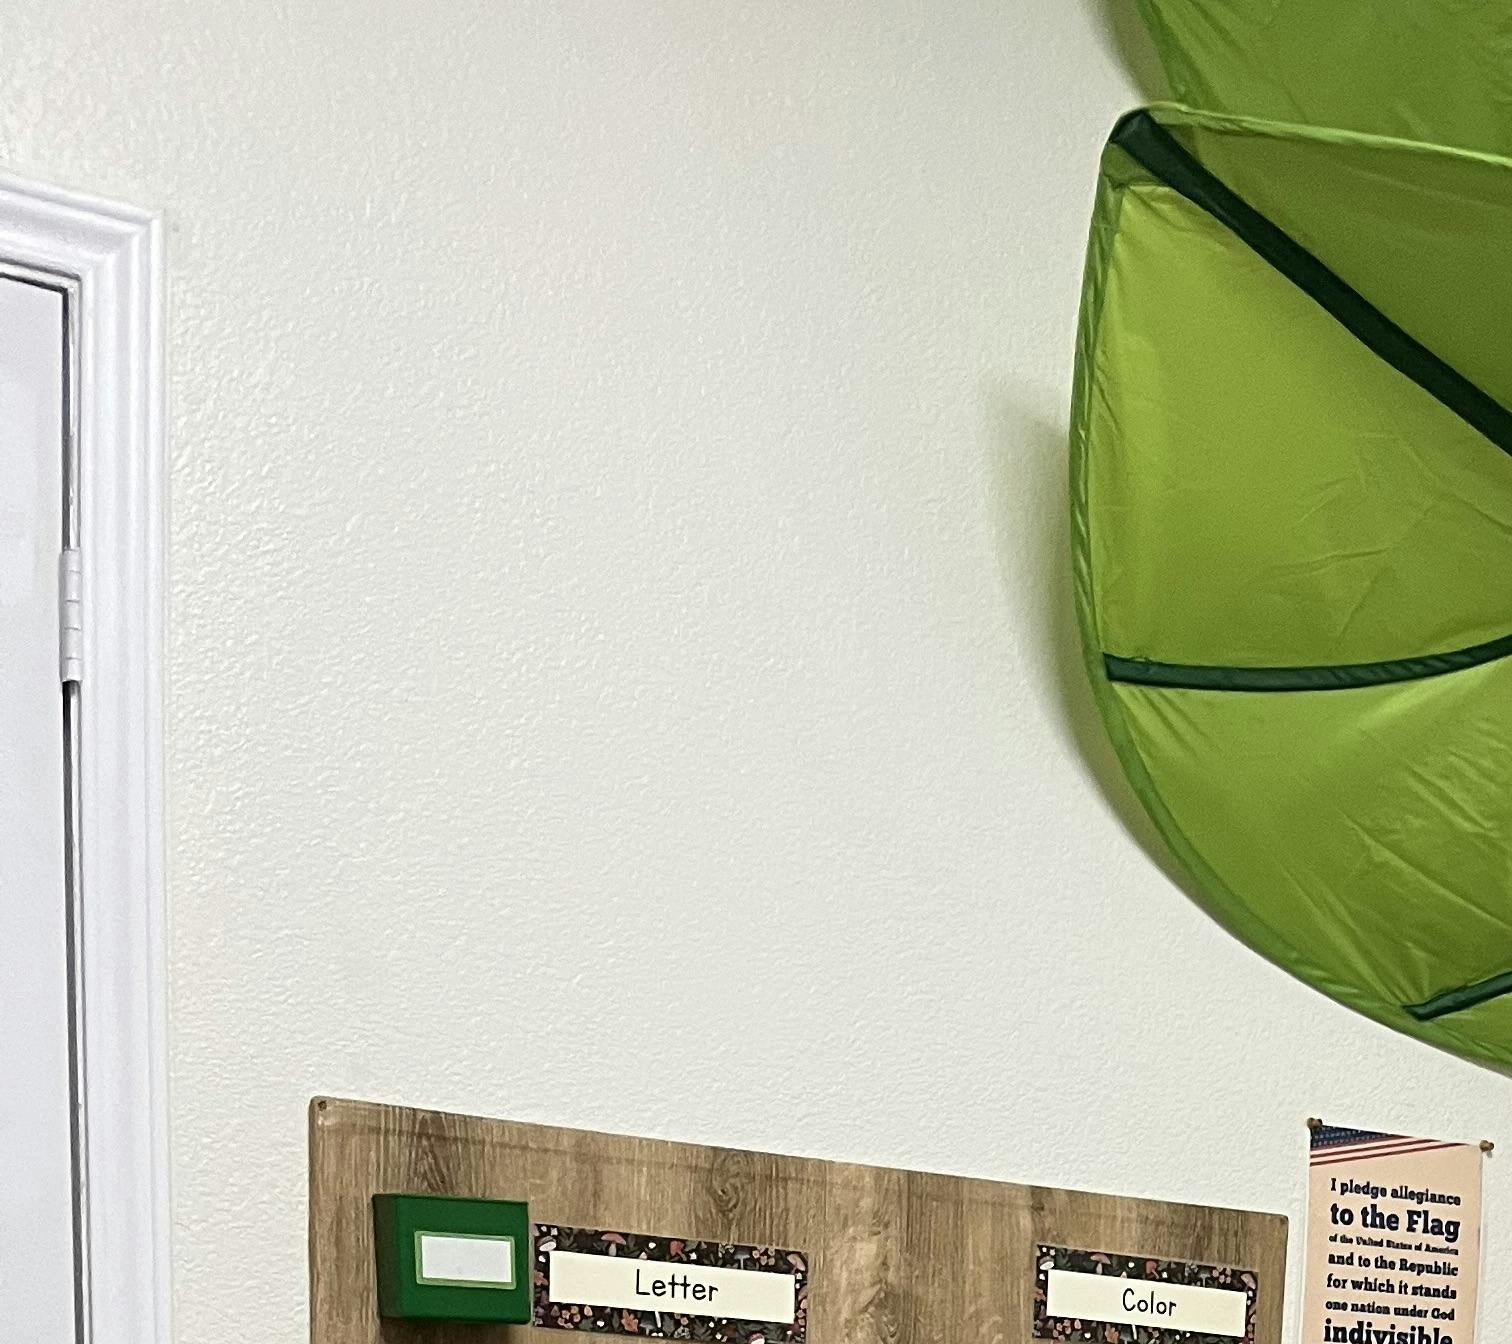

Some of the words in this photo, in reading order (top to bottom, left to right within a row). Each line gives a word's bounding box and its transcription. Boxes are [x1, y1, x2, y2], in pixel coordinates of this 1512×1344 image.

[1331, 1178, 1336, 1191] I
[1341, 1179, 1387, 1199] pledge
[1391, 1185, 1461, 1205] allegiance
[1331, 1203, 1354, 1225] to
[1361, 1204, 1399, 1231] the
[1407, 1210, 1460, 1242] Flag
[1328, 1252, 1354, 1265] and
[1358, 1256, 1370, 1267] to
[1375, 1256, 1395, 1270] the
[1399, 1259, 1458, 1276] Republic
[634, 1270, 718, 1302] Letter
[1327, 1273, 1347, 1288] for
[1351, 1277, 1394, 1293] which
[1399, 1280, 1408, 1294] it
[1411, 1285, 1456, 1299] stands
[1123, 1288, 1177, 1317] Color
[1326, 1301, 1347, 1311] one
[1351, 1301, 1390, 1314] nation
[1394, 1305, 1428, 1318] under
[1431, 1308, 1454, 1320] God
